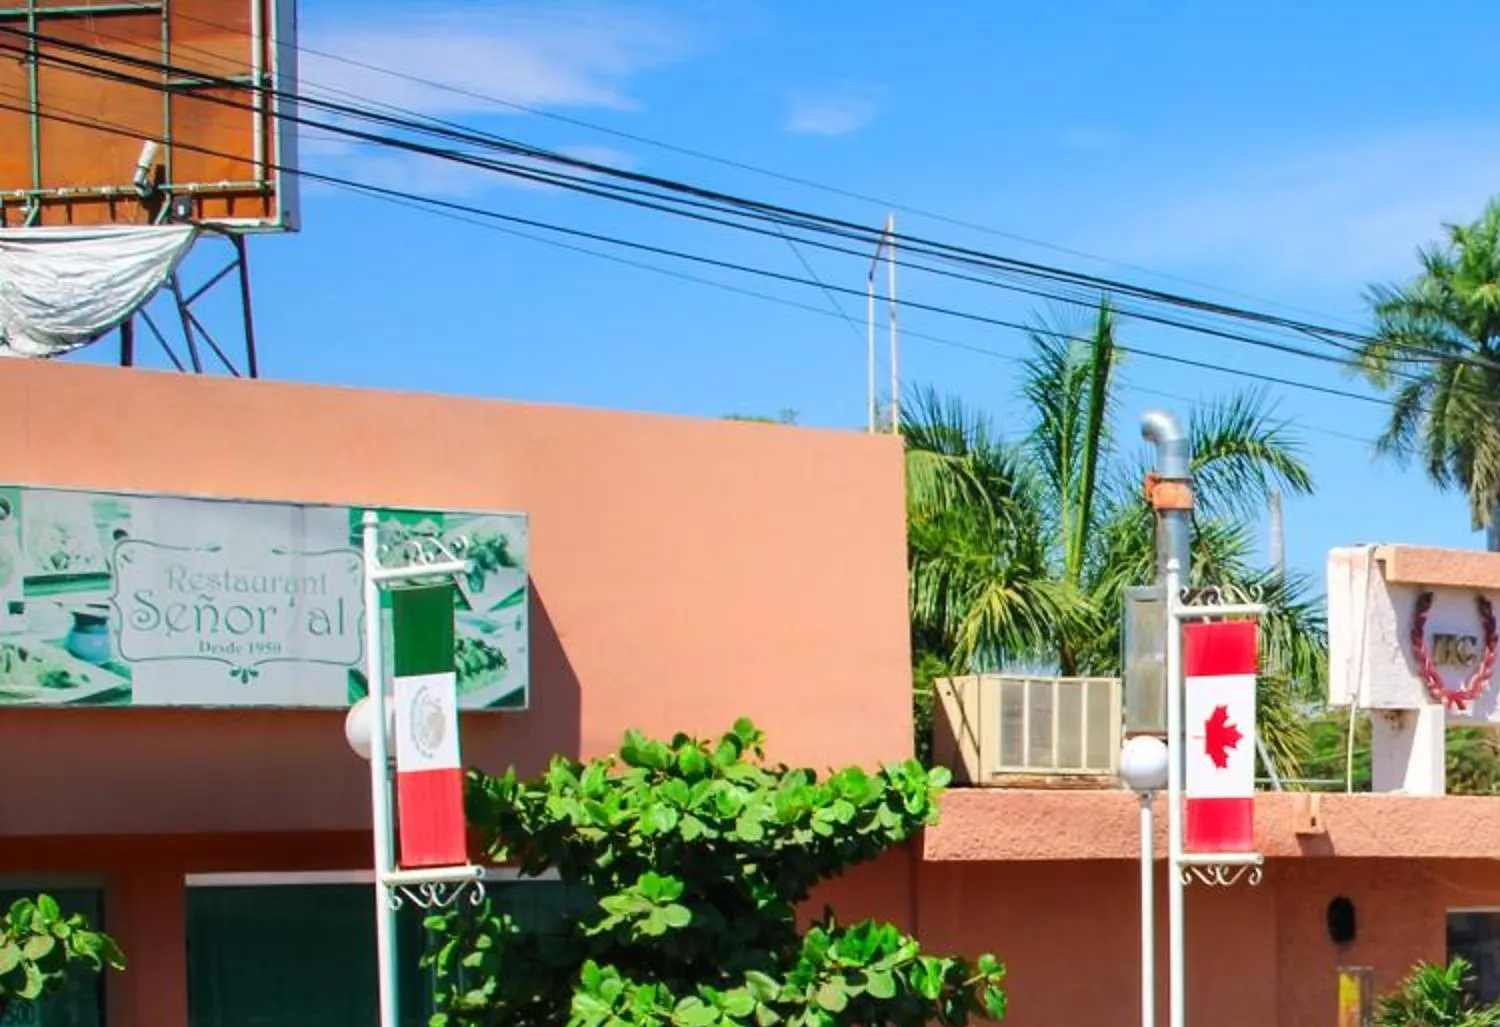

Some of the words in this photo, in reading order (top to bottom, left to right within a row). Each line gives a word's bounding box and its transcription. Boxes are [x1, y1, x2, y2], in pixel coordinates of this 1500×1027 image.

[168, 564, 327, 595] Restaurant
[129, 590, 277, 636] Señor
[199, 640, 240, 654] Desde
